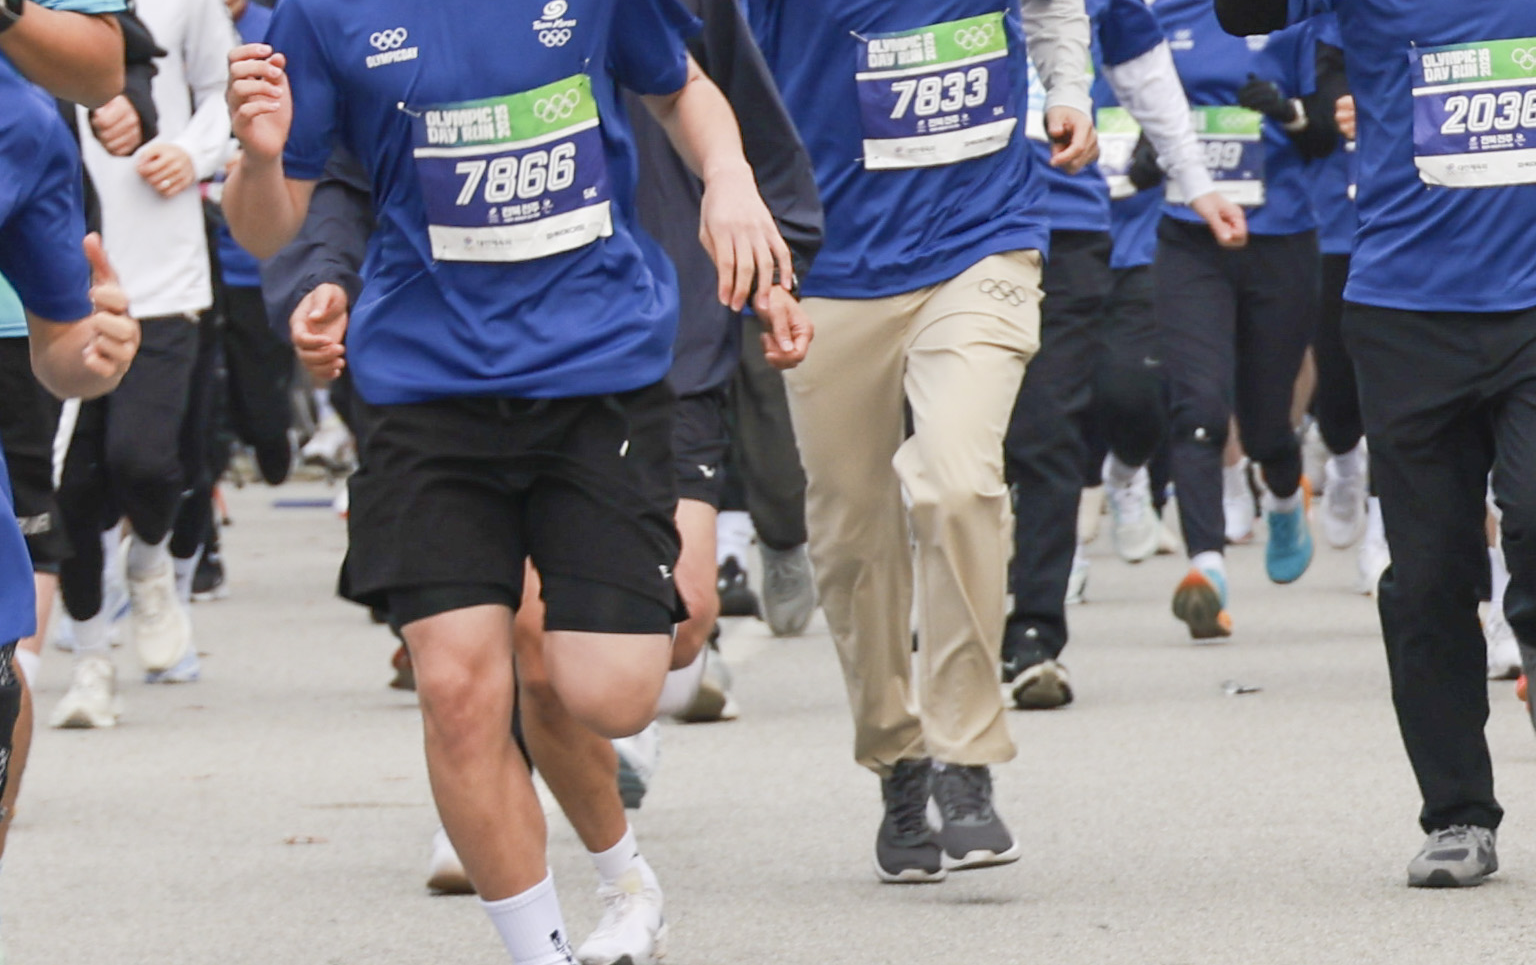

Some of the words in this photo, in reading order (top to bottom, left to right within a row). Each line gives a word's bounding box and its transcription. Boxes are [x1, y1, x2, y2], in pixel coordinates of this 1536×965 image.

[1422, 49, 1477, 68] OLYMPIC
[1423, 66, 1450, 83] DAY
[1452, 64, 1479, 79] RUN
[889, 66, 989, 119] 7833
[425, 106, 493, 128] OLYMPIC
[427, 126, 458, 144] DAY
[455, 141, 576, 206] 7866
